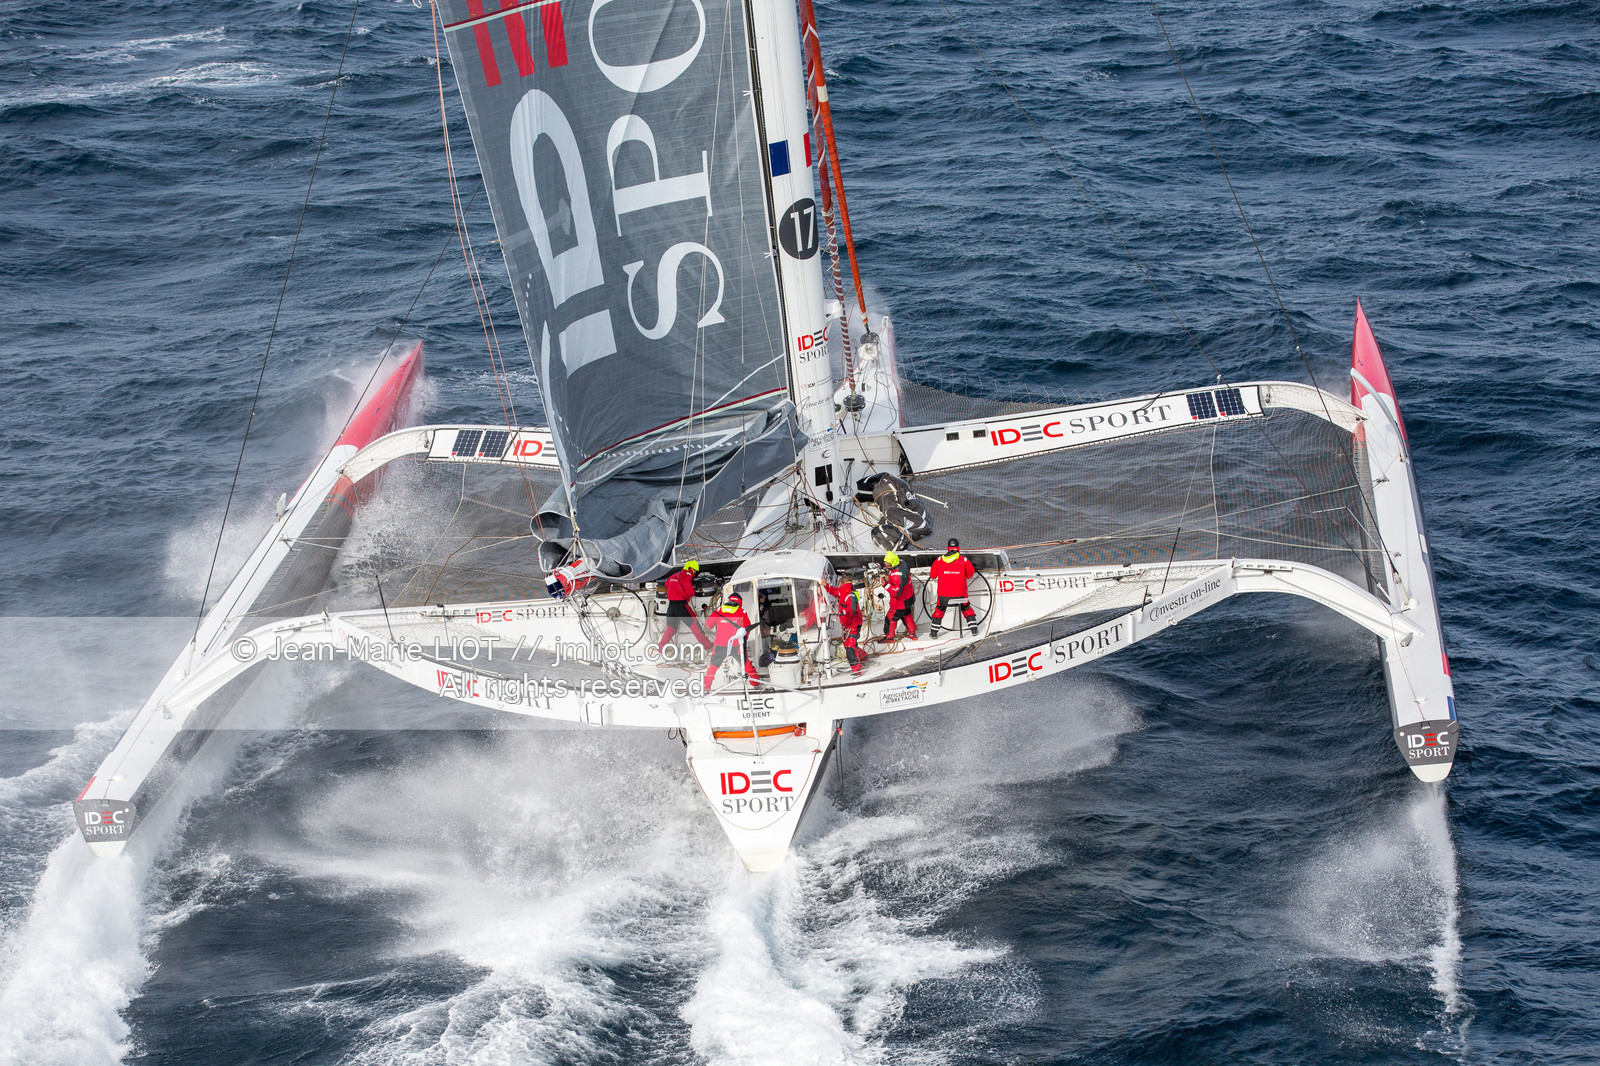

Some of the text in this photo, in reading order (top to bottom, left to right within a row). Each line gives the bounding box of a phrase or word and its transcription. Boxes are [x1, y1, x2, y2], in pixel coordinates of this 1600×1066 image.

[790, 205, 815, 252] 17
[990, 404, 1172, 446] IDEC SPORT
[999, 576, 1090, 592] IDEC SPORT
[1190, 579, 1221, 600] on-line
[477, 605, 569, 624] IDEC SPORT
[988, 623, 1123, 683] IDEC SPORT
[1407, 731, 1450, 748] IDEC
[1408, 746, 1450, 759] SPORT
[720, 769, 793, 795] IDEC
[722, 796, 794, 814] SPORT
[84, 810, 124, 825] IDEC
[86, 825, 125, 836] SPORT
